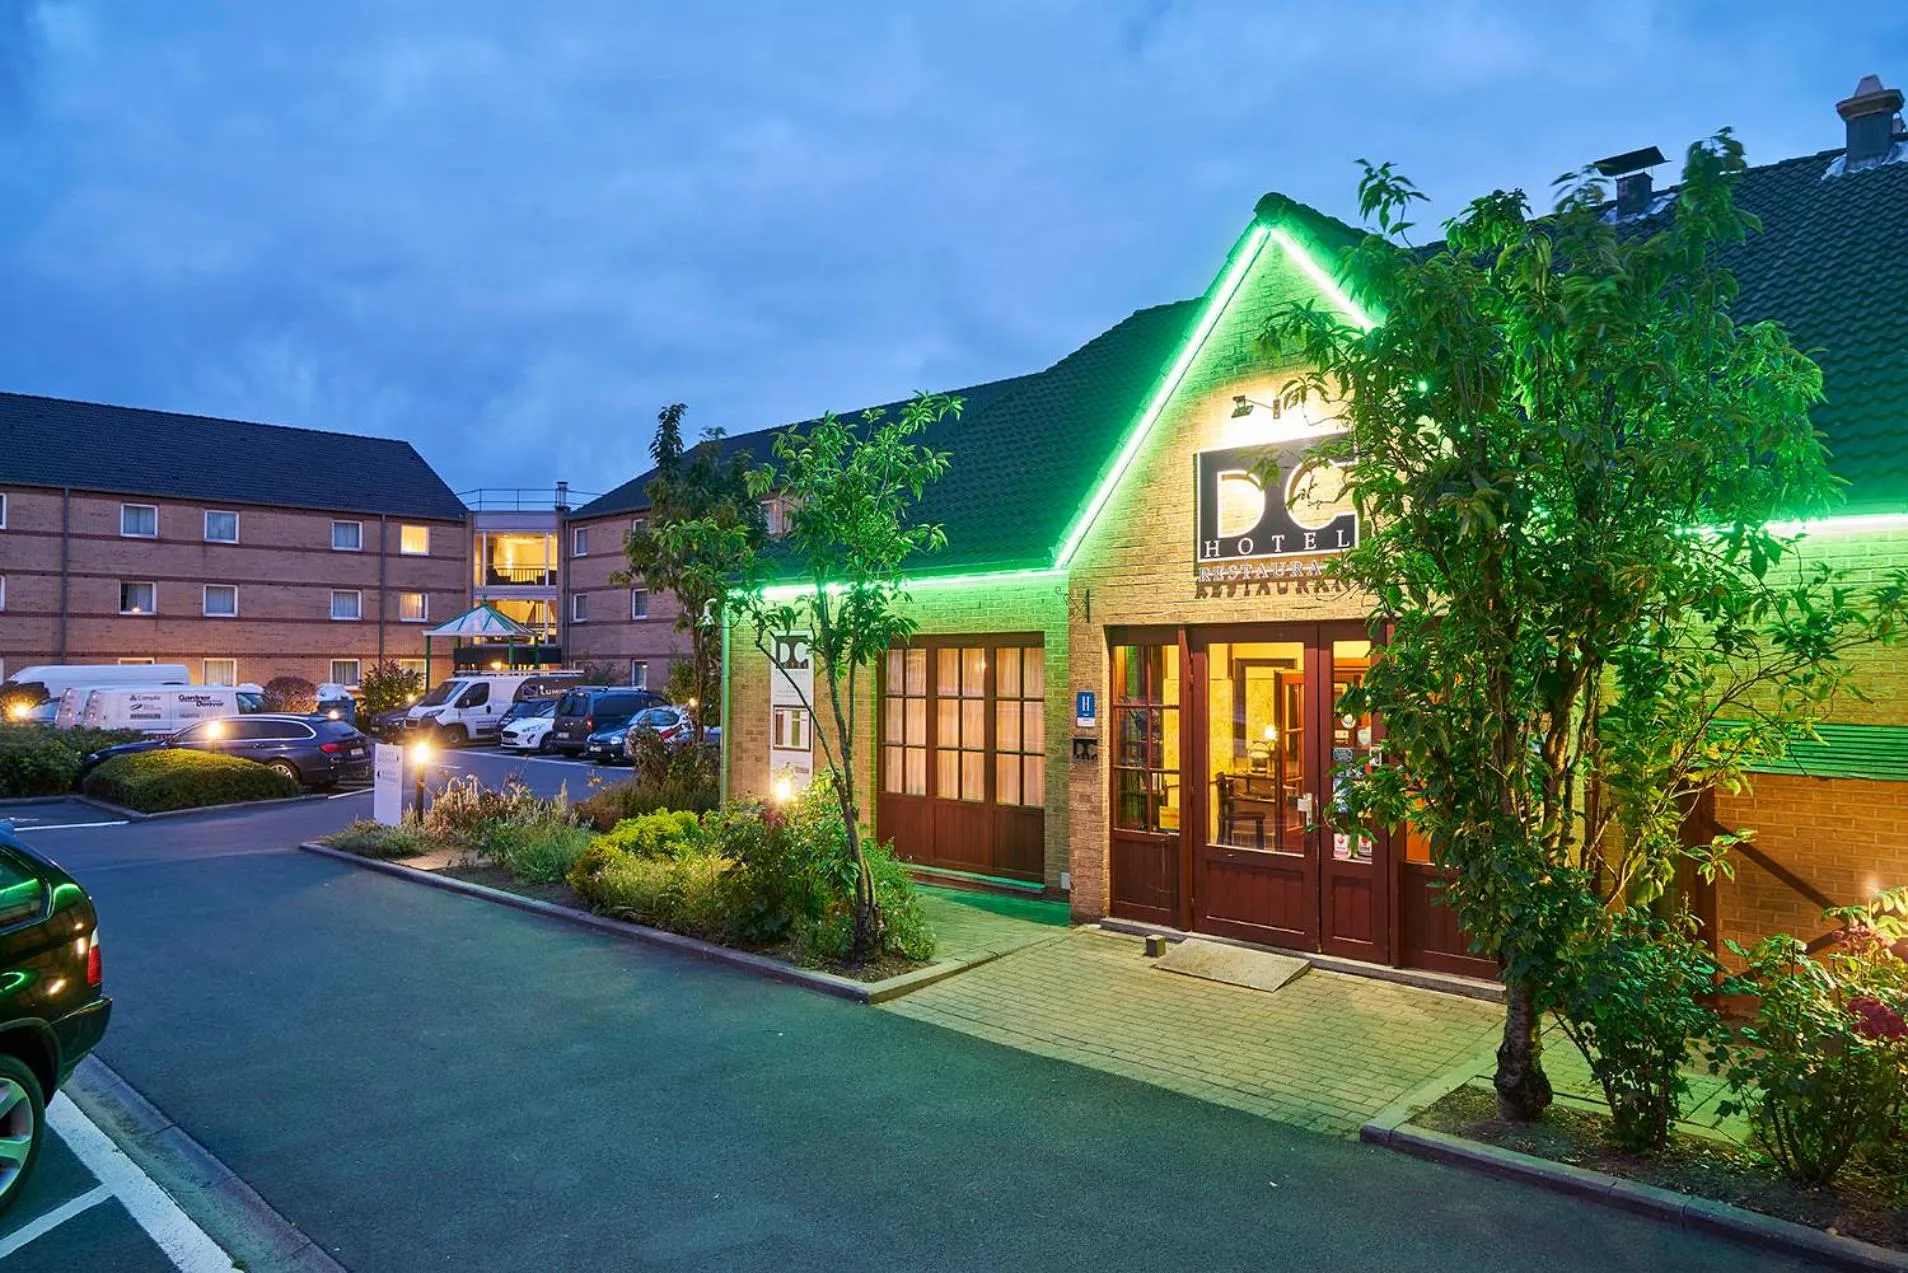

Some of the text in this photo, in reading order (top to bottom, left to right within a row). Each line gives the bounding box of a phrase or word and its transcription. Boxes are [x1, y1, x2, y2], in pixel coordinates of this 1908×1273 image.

[1216, 457, 1359, 539] DC
[1203, 529, 1351, 558] HOTEL
[1198, 559, 1355, 583] RESTAURA
[178, 694, 211, 702] Gardner
